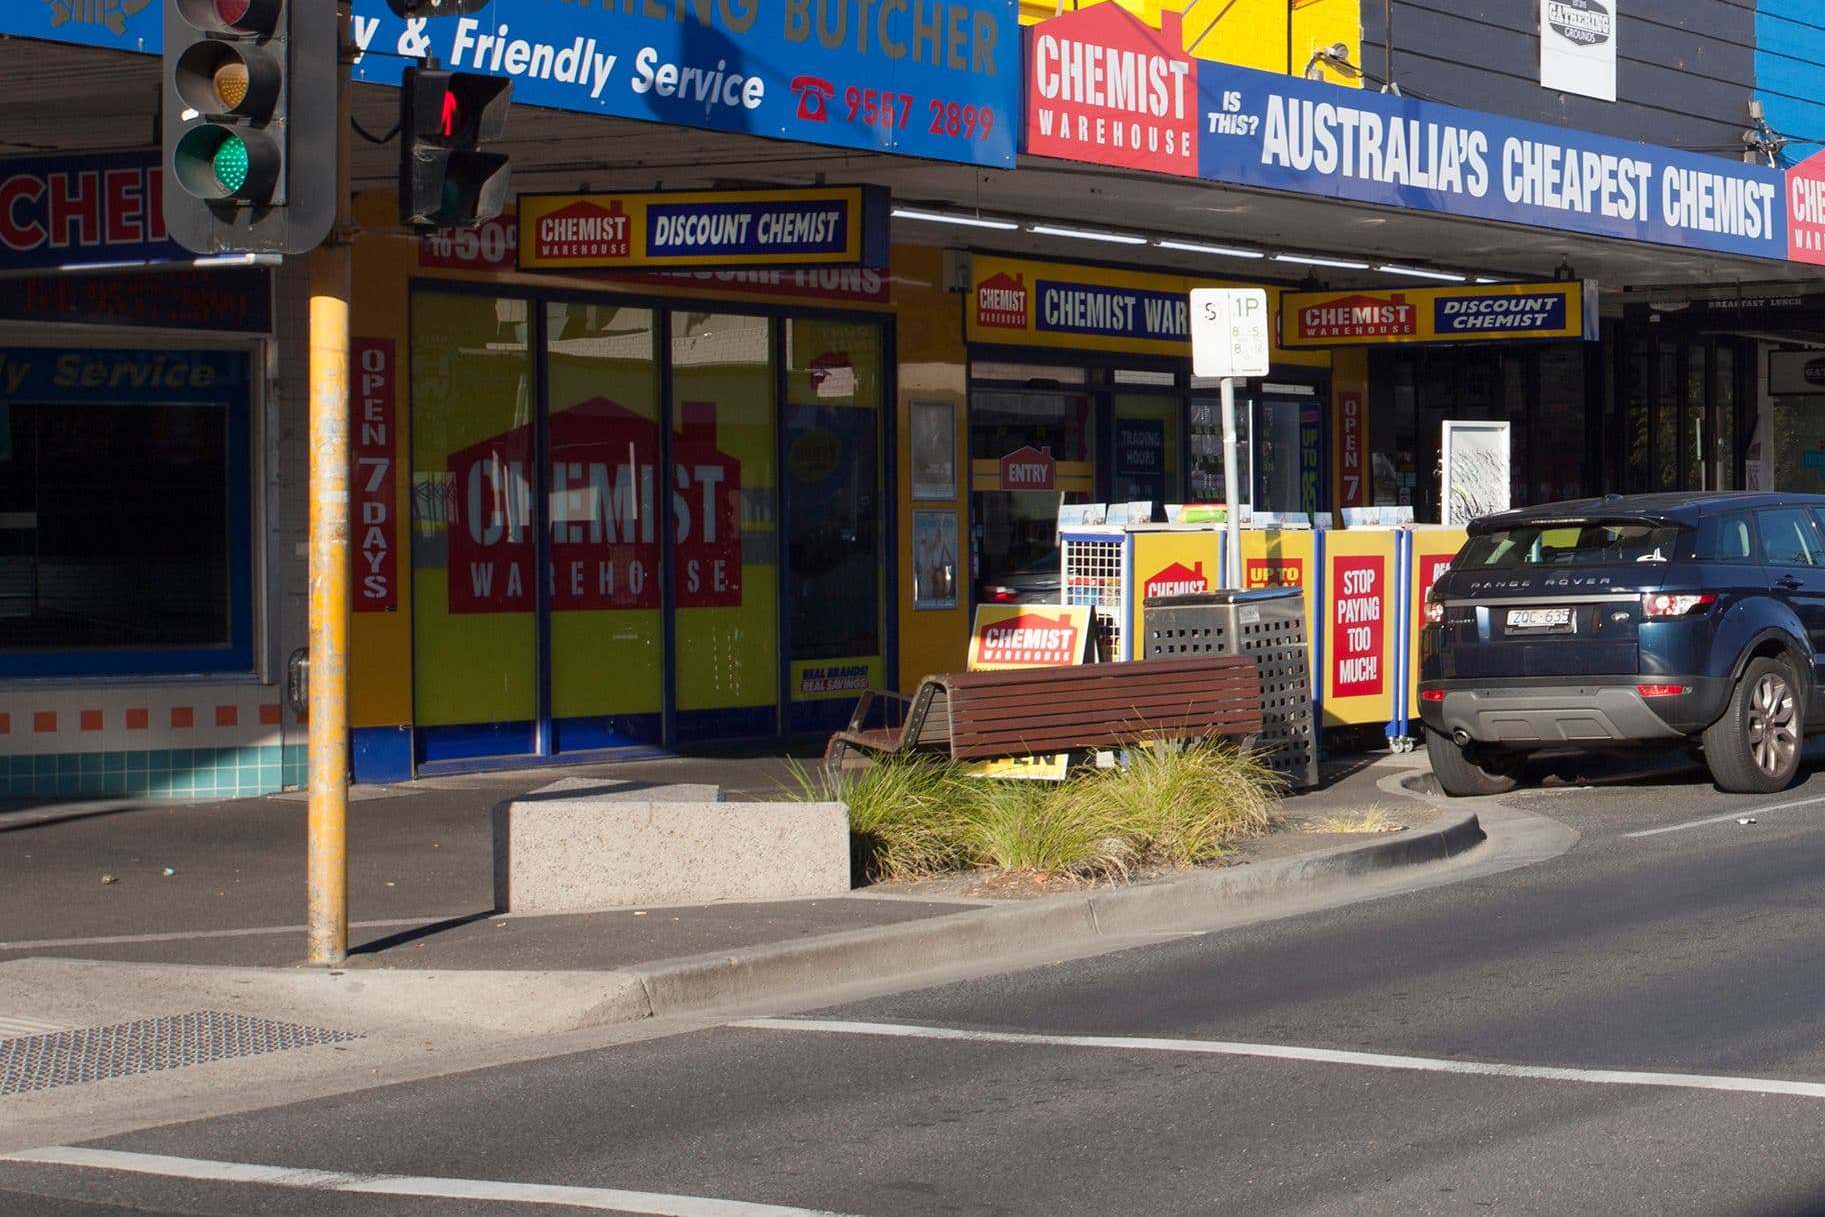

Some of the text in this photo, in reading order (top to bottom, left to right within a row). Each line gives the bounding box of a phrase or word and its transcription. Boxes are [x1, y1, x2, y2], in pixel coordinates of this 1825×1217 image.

[1549, 4, 1610, 34] GATHERING
[1565, 27, 1596, 43] GROUNDS
[397, 16, 431, 58] &
[451, 18, 617, 98] Friendly
[631, 46, 765, 110] Service
[1036, 34, 1189, 120] CHEMIST
[845, 86, 994, 142] 9557 2899
[1222, 90, 1241, 112] IS
[1038, 107, 1191, 157] WAREHOUSE
[1207, 113, 1260, 136] THIS?
[1261, 93, 1775, 240] AUSTRALIA'S CHEAPEST CHEMIST
[541, 216, 628, 242] CHEMIST
[655, 211, 841, 247] DISCOUNT CHEMIST
[541, 242, 628, 257] WAREHOUSE
[979, 287, 1025, 312] CHEMIST
[1045, 288, 1136, 331] CHEMIST
[1235, 297, 1259, 317] 1P
[1443, 296, 1558, 315] DISCOUNT
[980, 313, 1025, 326] WAREHOUSE
[1305, 305, 1410, 326] CHEMIST
[1453, 313, 1548, 329] CHEMIST
[1306, 324, 1411, 336] WAREHOUSE
[53, 353, 217, 389] Service
[361, 348, 387, 446] OPEN
[1344, 399, 1358, 469] OPEN
[358, 457, 389, 492] 7
[1008, 463, 1048, 483] ENTRY
[1343, 475, 1360, 501] 7
[467, 458, 725, 547] CHEMIST
[363, 502, 388, 600] DAYS
[1250, 567, 1275, 582] UP
[1343, 569, 1376, 595] STOP
[1470, 577, 1612, 589] RANGE ROVER
[1337, 596, 1380, 624] PAYING
[984, 628, 1074, 650] CHEMIST
[1347, 626, 1371, 653] TOO
[983, 651, 1072, 662] WAREHOUSE
[1339, 656, 1378, 685] MUCH!
